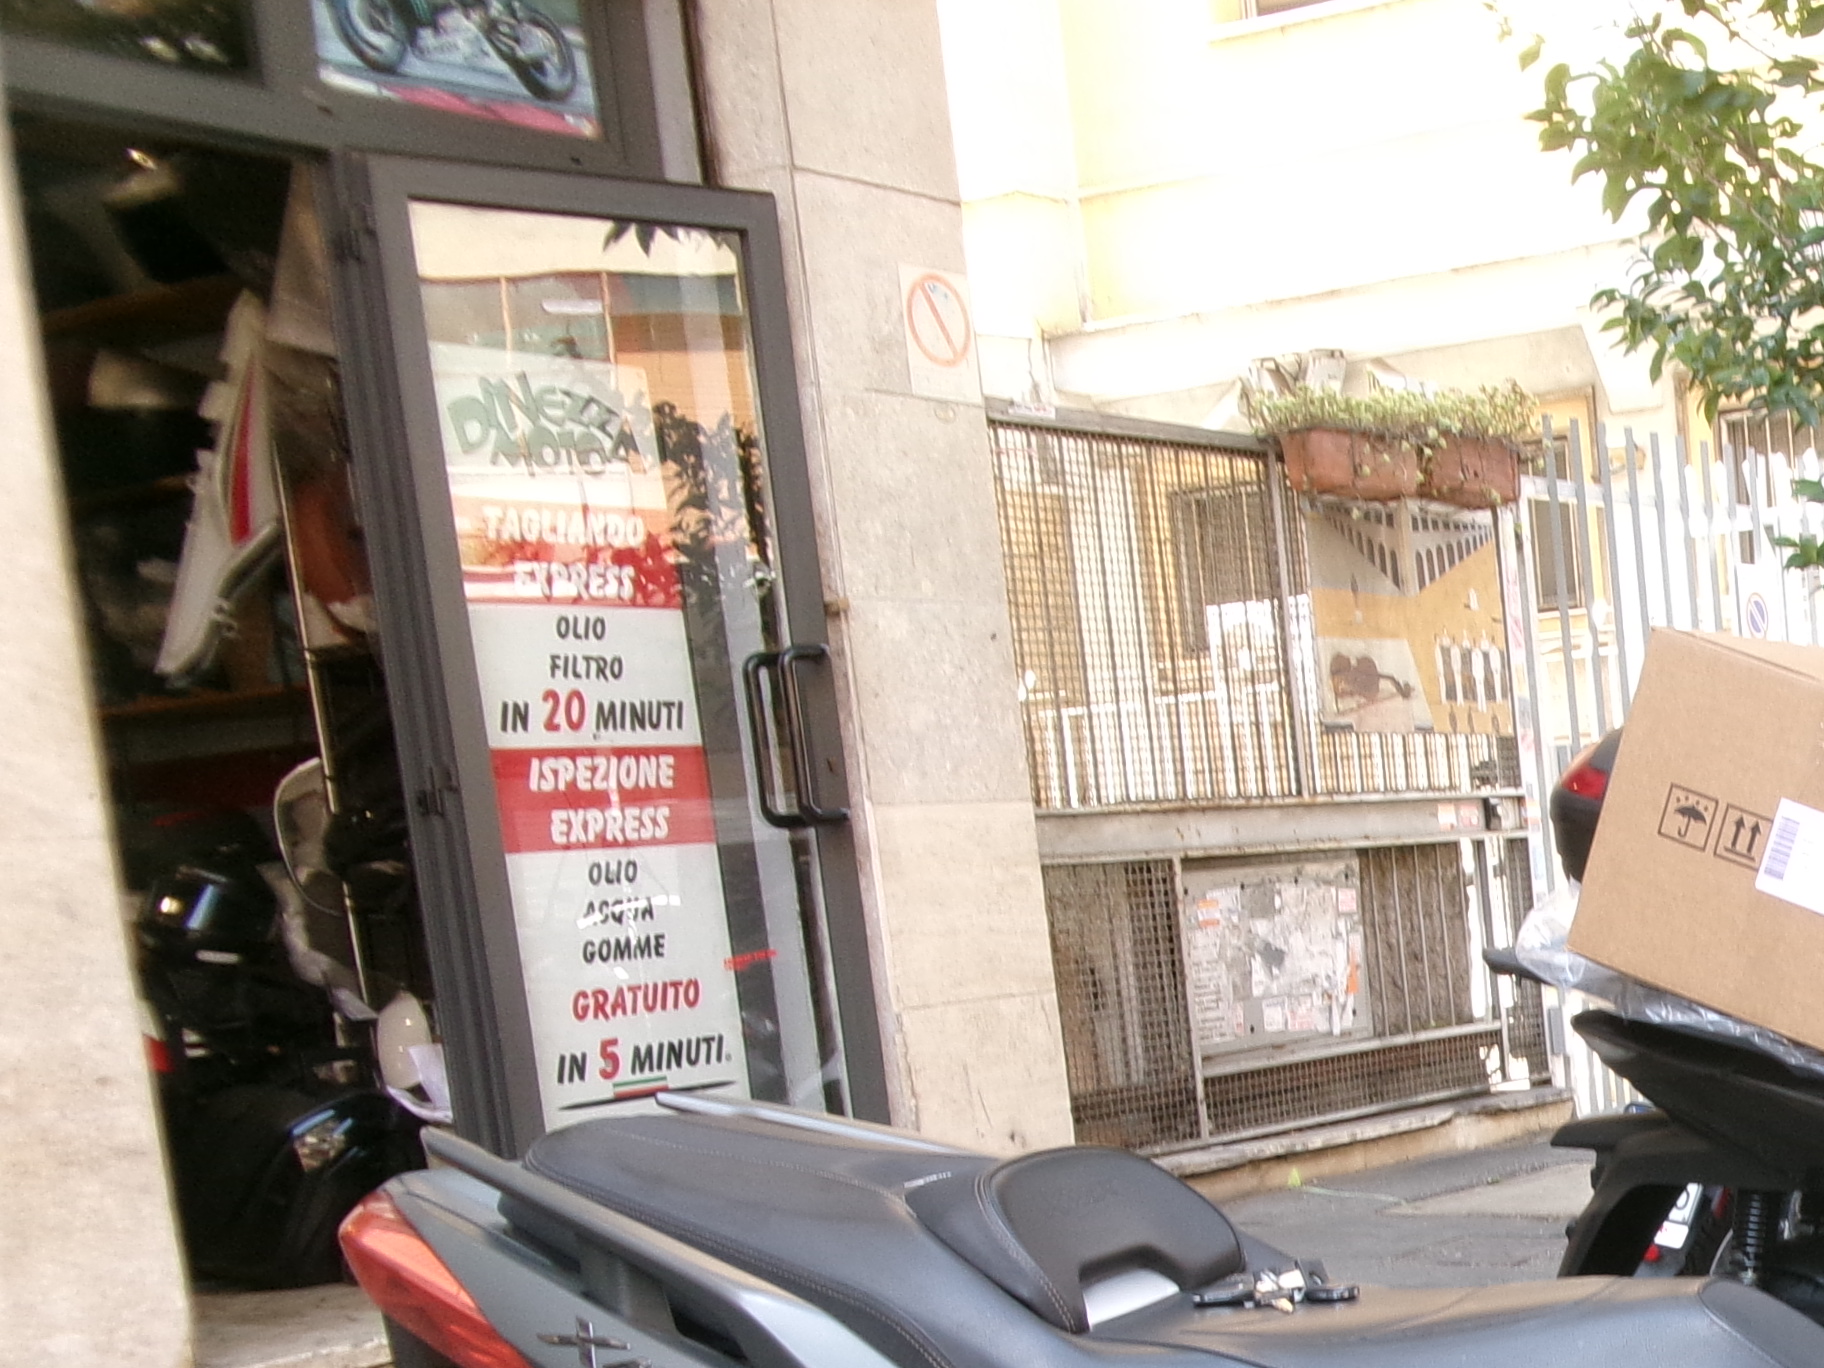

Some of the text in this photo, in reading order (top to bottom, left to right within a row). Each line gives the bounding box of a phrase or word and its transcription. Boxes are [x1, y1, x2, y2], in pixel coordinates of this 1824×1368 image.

[482, 506, 645, 548] TAGLIANDO
[513, 560, 636, 600] EXPRESS
[556, 616, 606, 640] OLIO
[549, 655, 624, 681] FILTRO
[500, 689, 684, 732] IN 20 MINUTI
[529, 755, 675, 792] ISPEZIONE
[550, 806, 670, 845] EXPRESS
[588, 860, 638, 885] OLIO
[583, 897, 655, 926] ACQUA
[582, 934, 665, 964] GOMME
[572, 979, 700, 1022] GRATUITO
[557, 1054, 587, 1084] IN
[599, 1038, 621, 1079] 5
